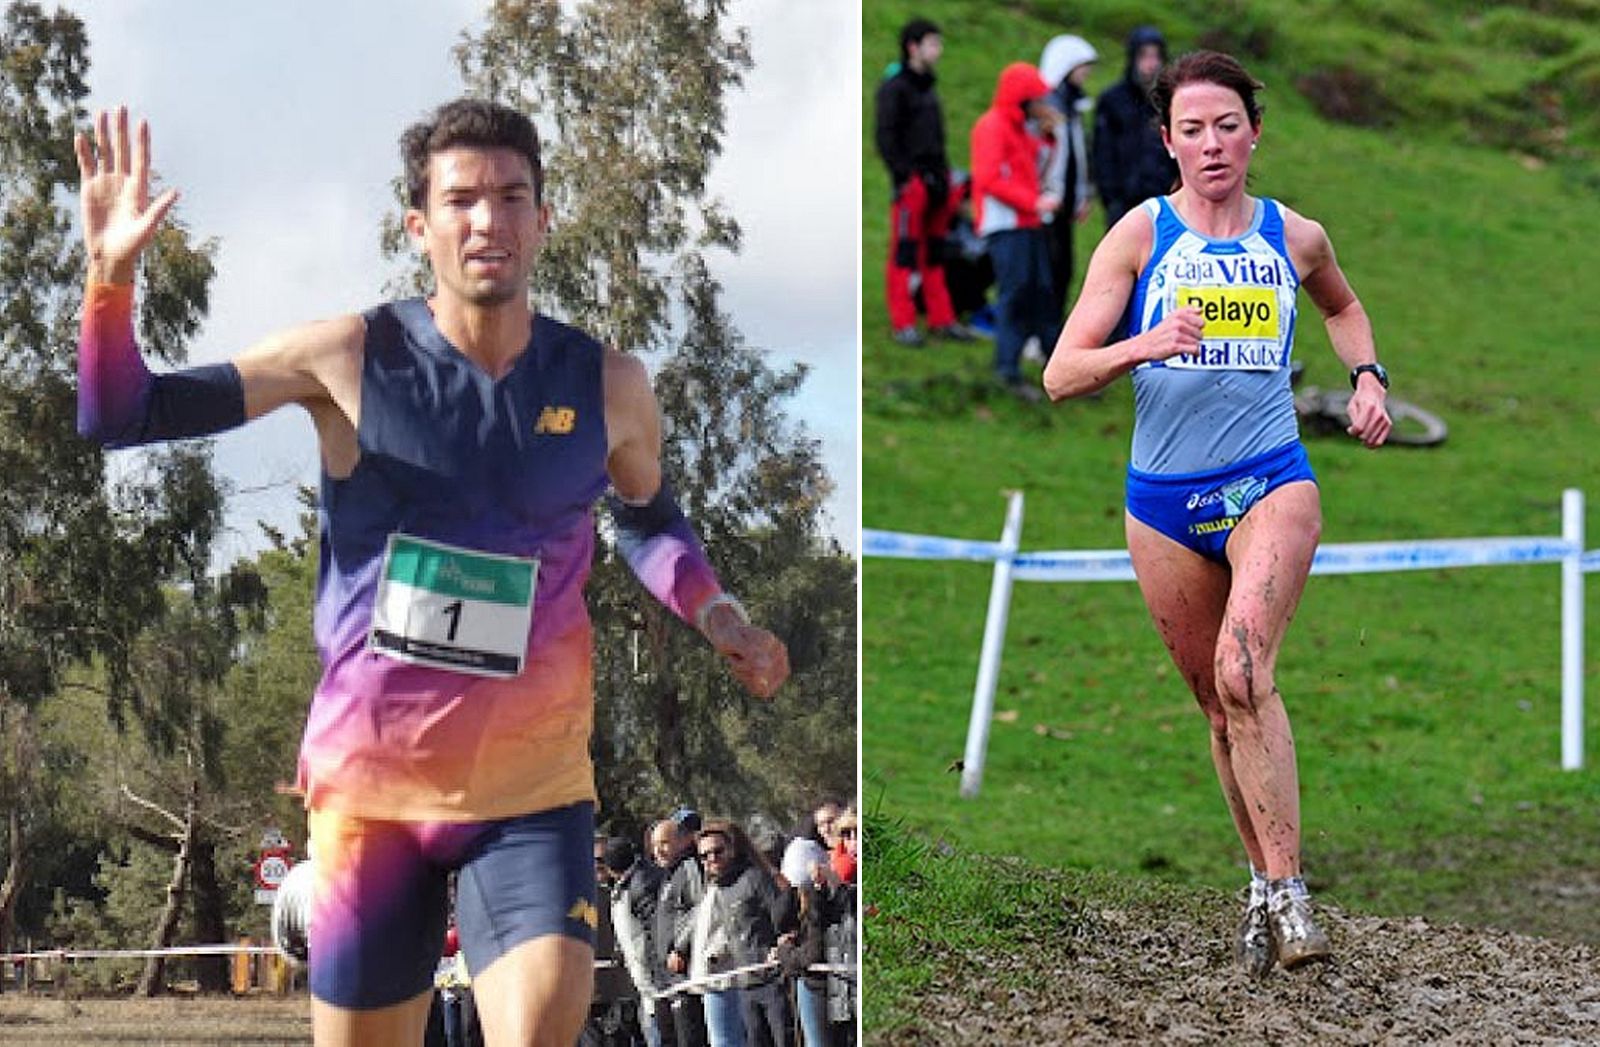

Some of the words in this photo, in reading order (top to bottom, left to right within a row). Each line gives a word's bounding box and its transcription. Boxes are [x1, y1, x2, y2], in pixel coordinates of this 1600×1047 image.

[1216, 256, 1282, 286] Vital
[1237, 344, 1281, 366] Kutx
[534, 406, 576, 434] NB
[443, 600, 463, 642] 1
